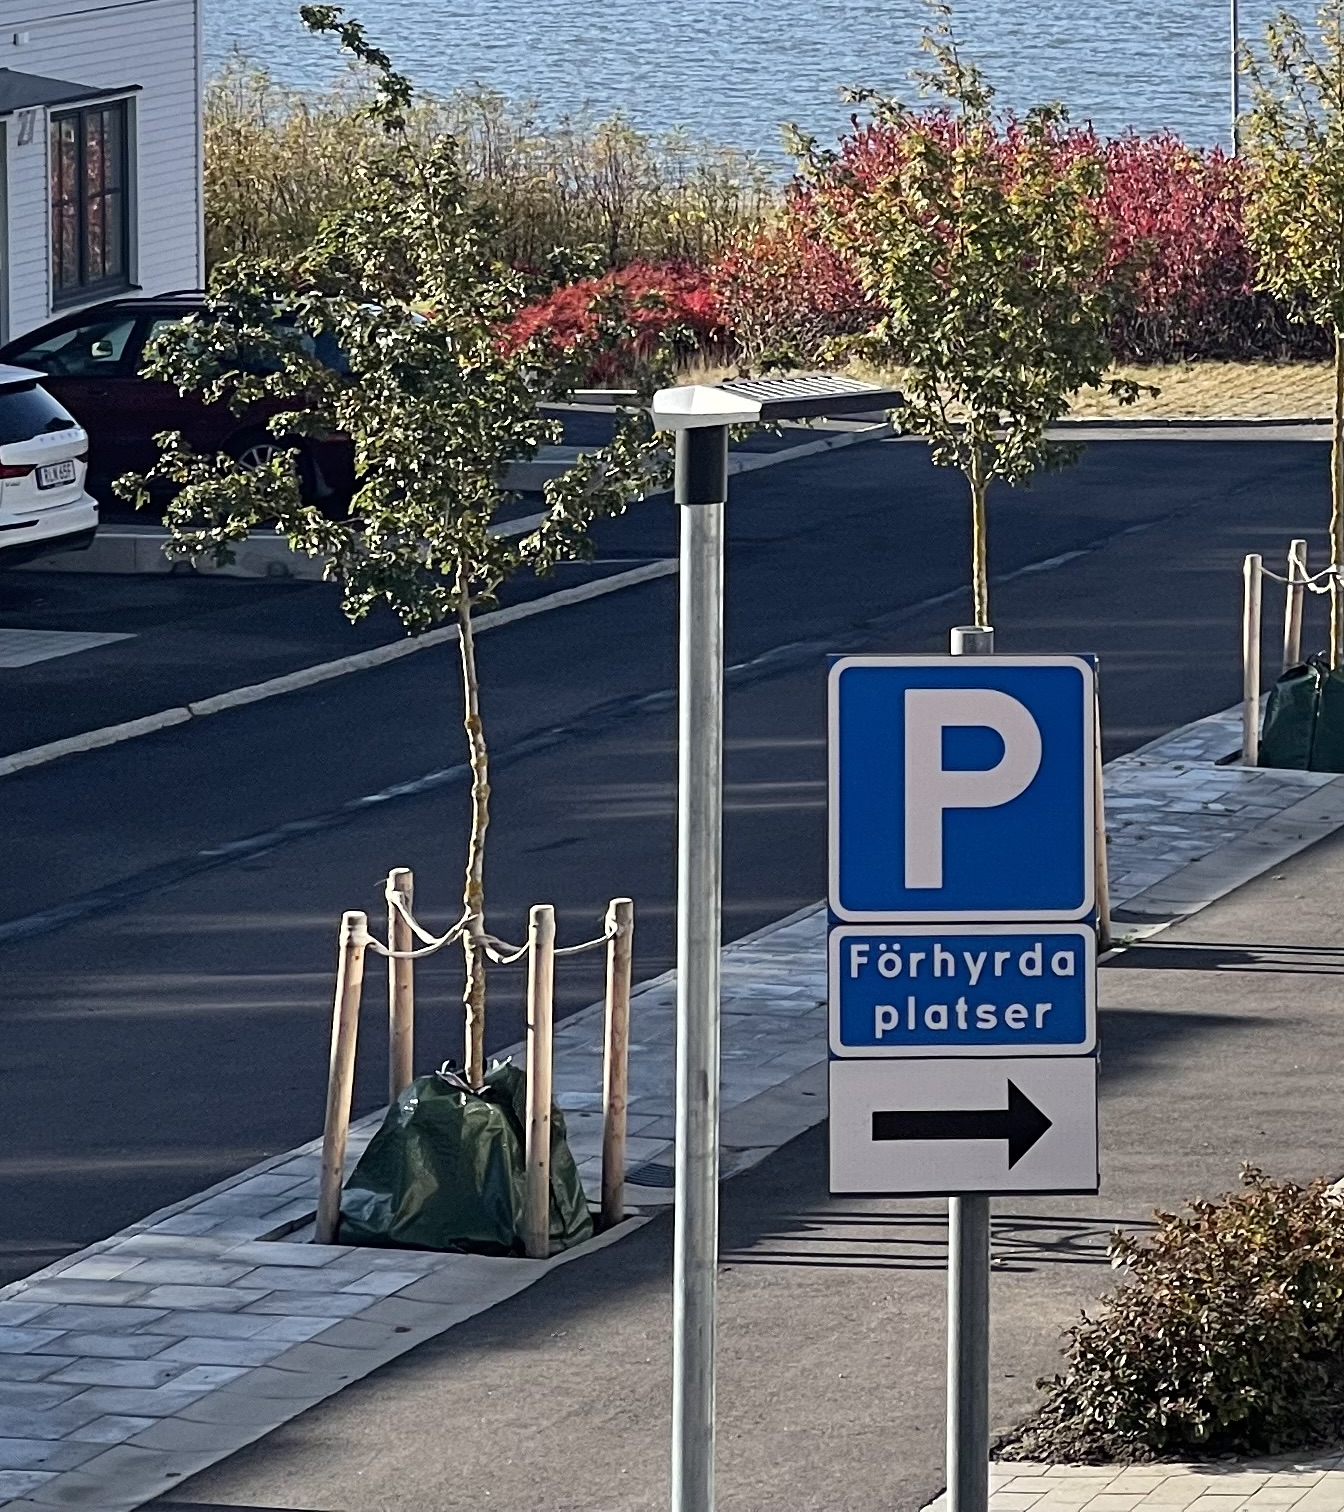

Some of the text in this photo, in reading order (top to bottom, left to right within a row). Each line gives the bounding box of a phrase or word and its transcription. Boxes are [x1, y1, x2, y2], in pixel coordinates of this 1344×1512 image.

[904, 688, 1043, 888] P
[849, 943, 1076, 986] Förhyrda
[875, 996, 1053, 1039] platser
